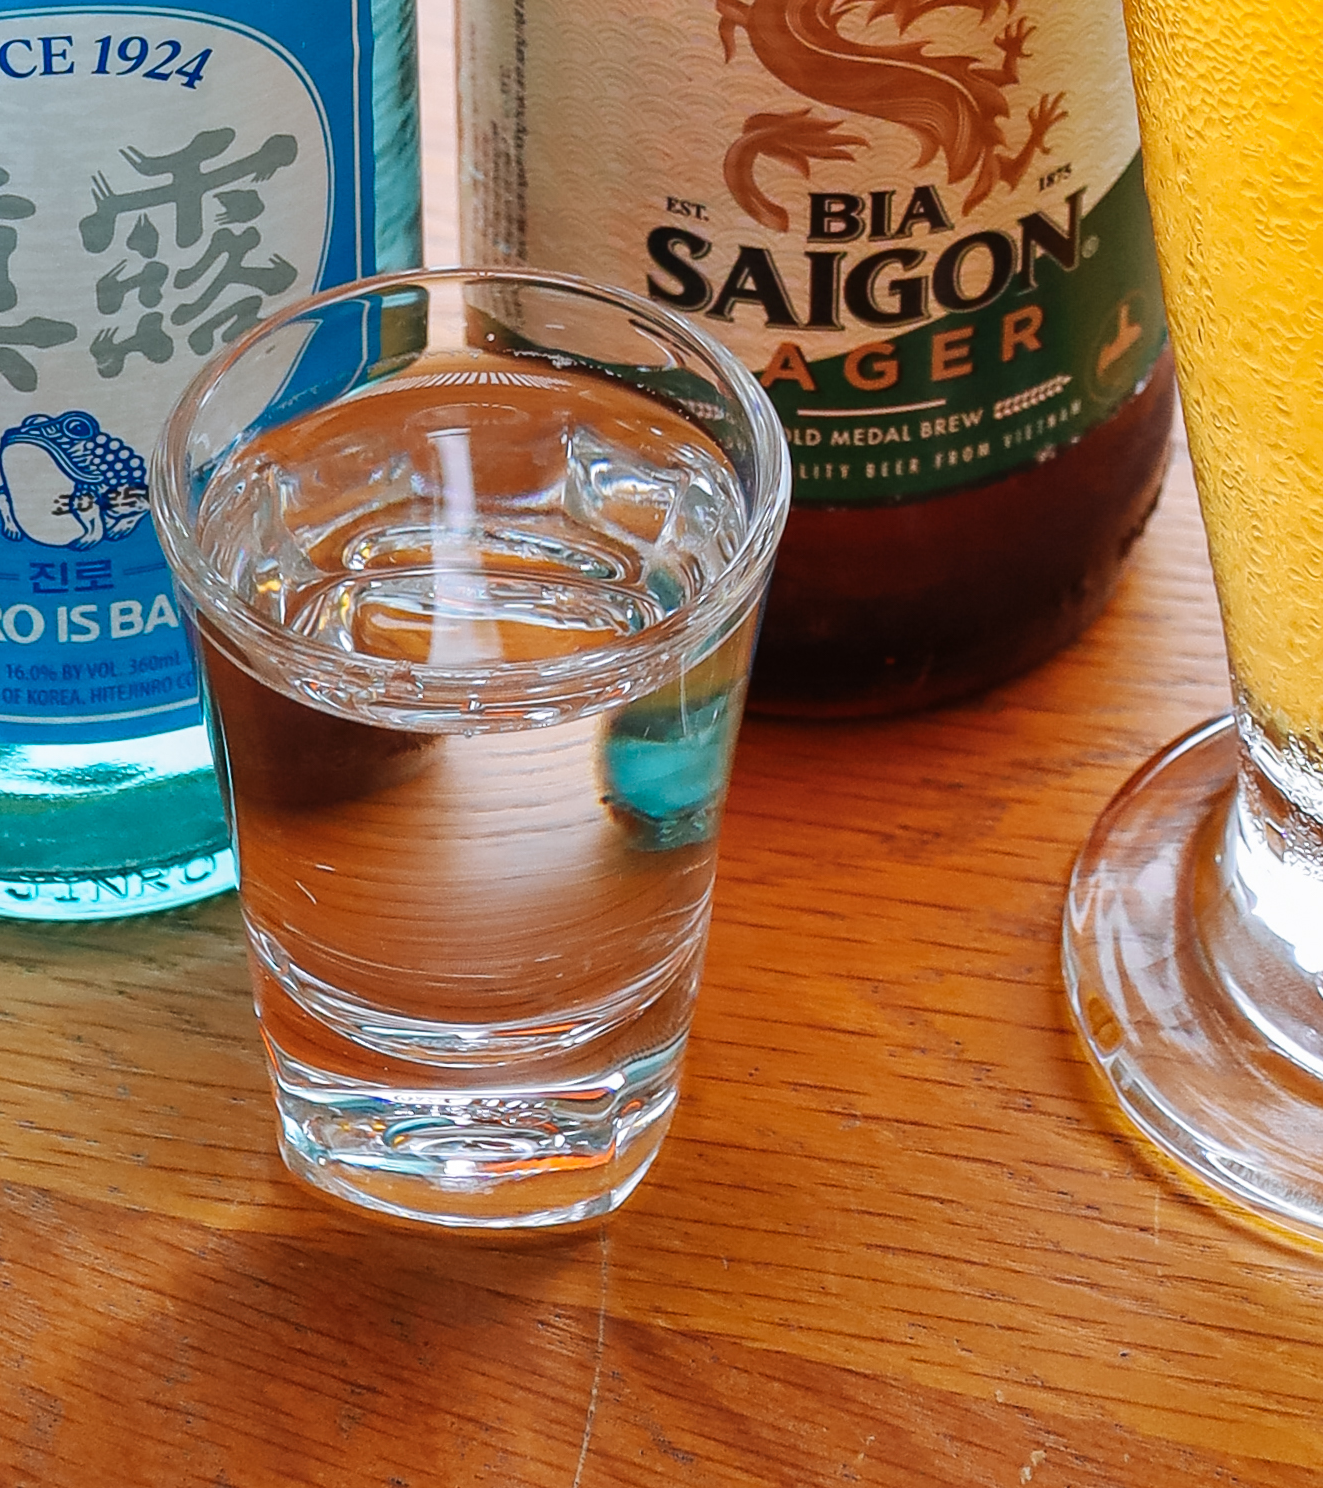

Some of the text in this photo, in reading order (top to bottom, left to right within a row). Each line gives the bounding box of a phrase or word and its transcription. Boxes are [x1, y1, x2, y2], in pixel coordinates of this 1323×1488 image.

[89, 34, 214, 91] 1924
[1037, 162, 1074, 193] 1875
[665, 195, 710, 223] EST.
[807, 184, 955, 244] BIA
[645, 186, 1087, 332] SAIGON
[760, 303, 1046, 392] AGER
[785, 406, 985, 448] OLD MEDAL BREW
[797, 462, 851, 481] LITY
[865, 456, 921, 480] BEER
[934, 441, 992, 471] FROM
[27, 558, 115, 595] 진로
[56, 604, 100, 643] IS
[109, 593, 180, 639] BA
[2, 686, 24, 706] OF
[90, 676, 173, 704] HITEJINRO
[6, 663, 58, 682] 16.0%
[61, 662, 84, 681] BY
[5, 854, 216, 903] JINRO
